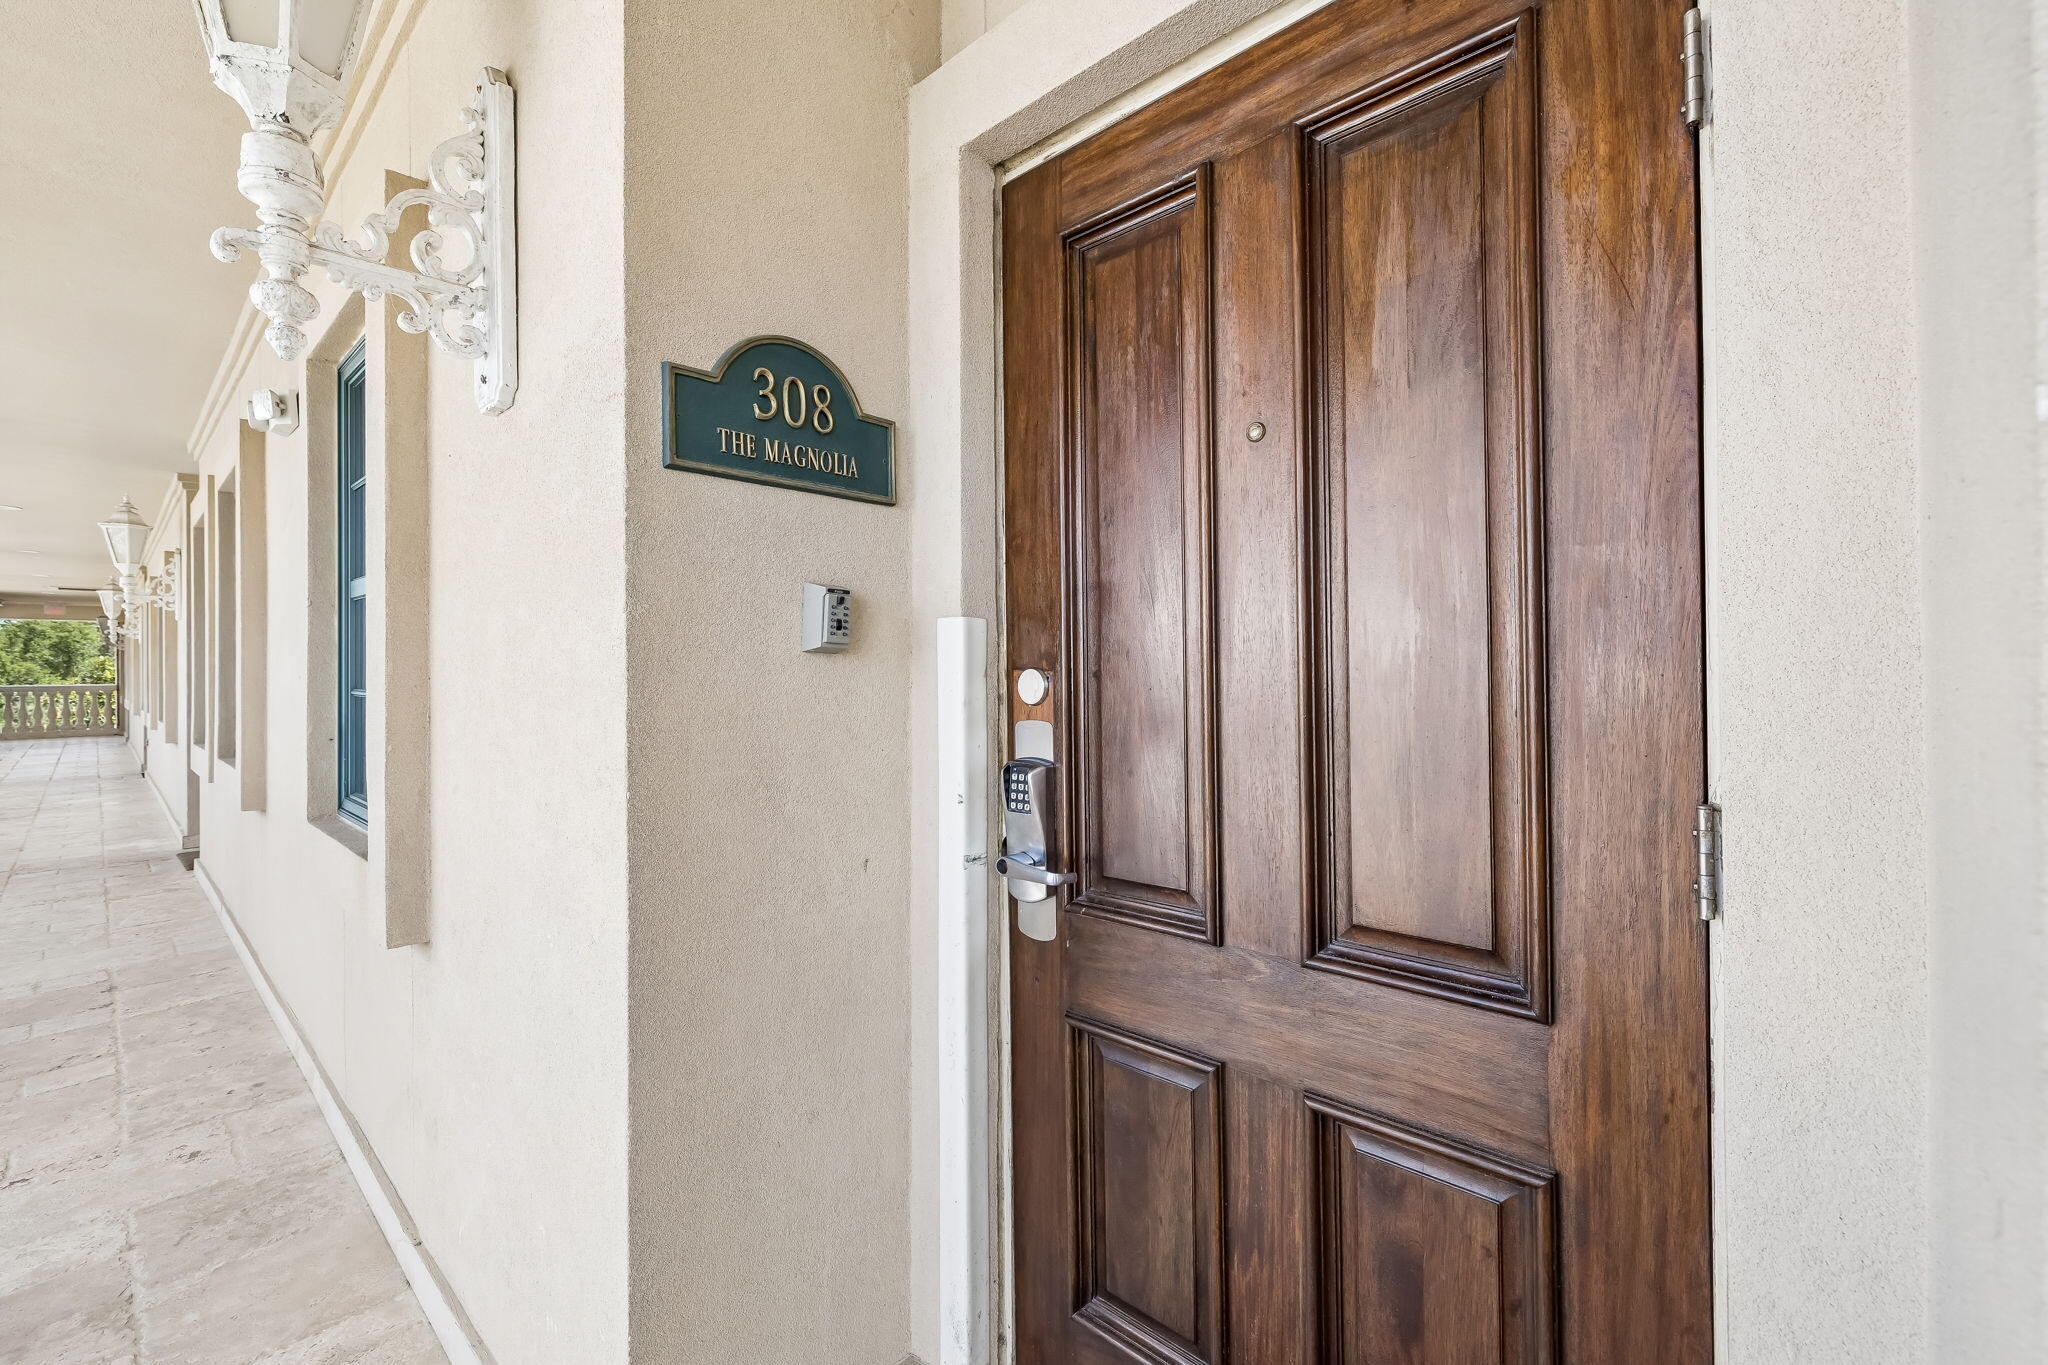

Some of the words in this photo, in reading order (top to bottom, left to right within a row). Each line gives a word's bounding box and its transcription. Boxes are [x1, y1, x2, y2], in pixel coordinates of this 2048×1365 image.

[753, 367, 834, 434] 308
[717, 427, 757, 458] THE
[764, 437, 858, 478] MAGNOLIA
